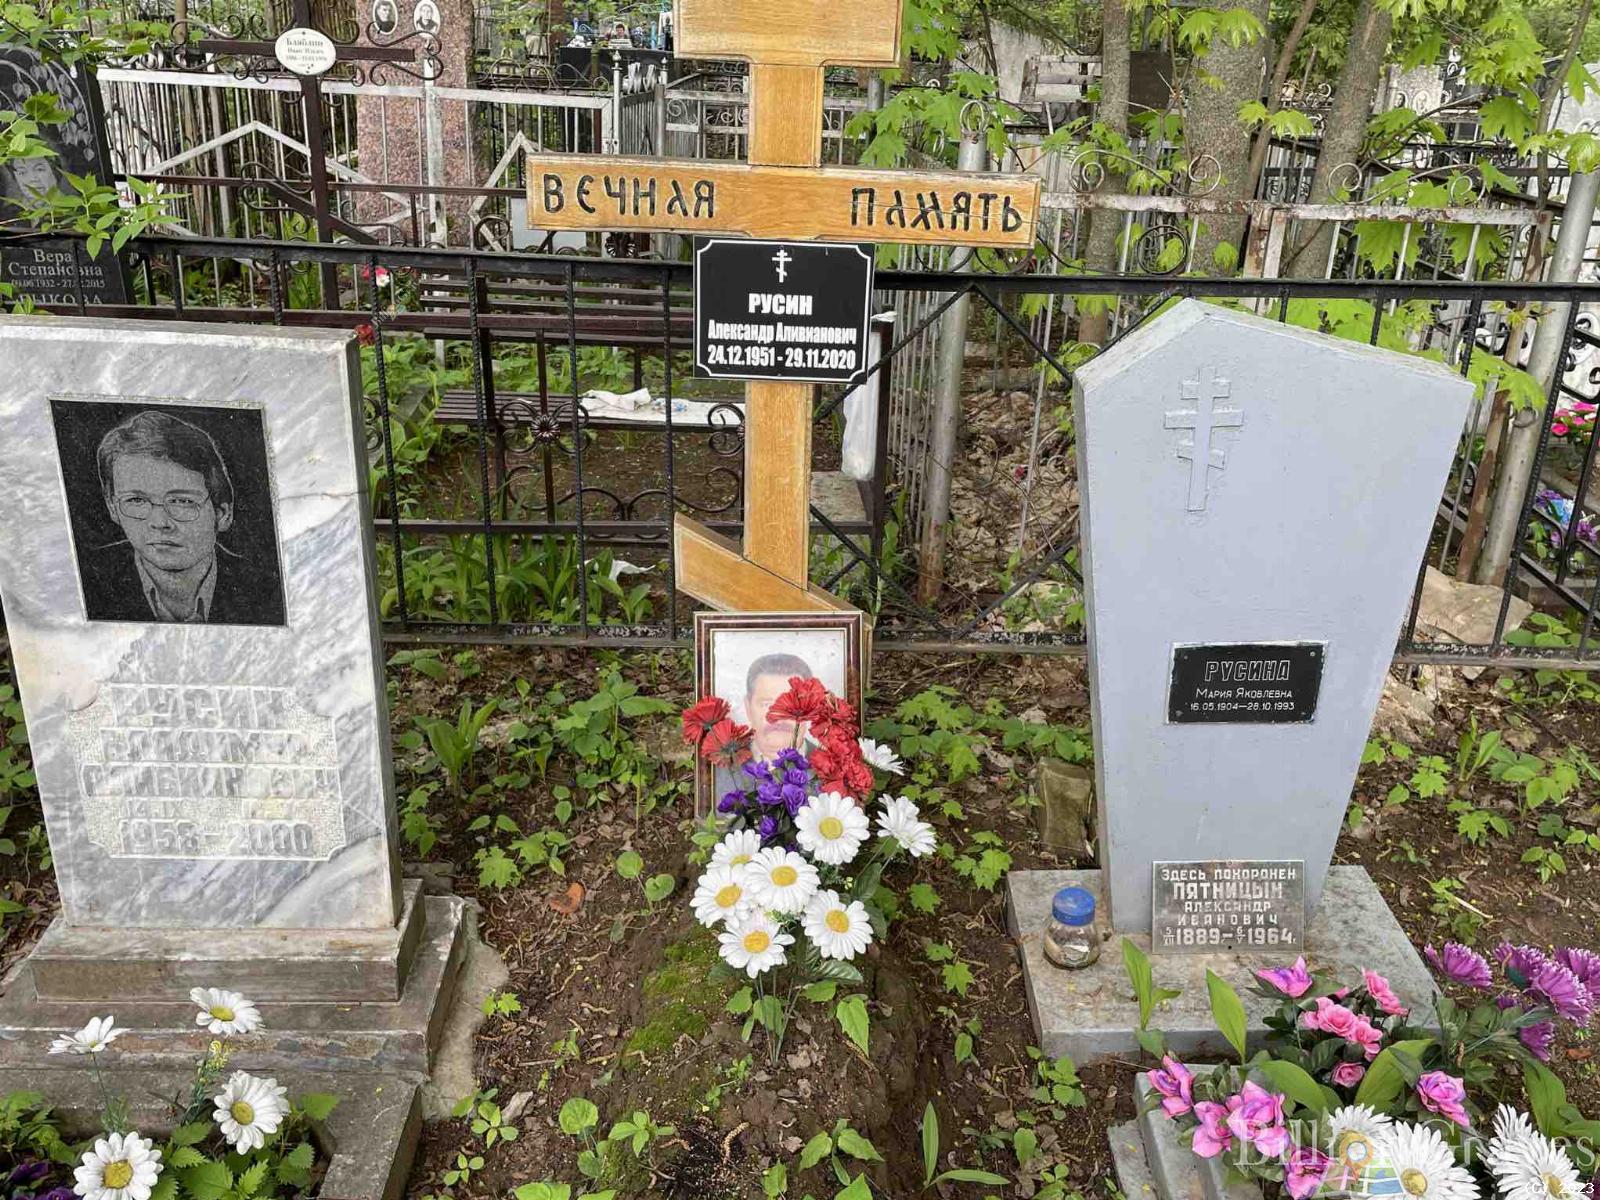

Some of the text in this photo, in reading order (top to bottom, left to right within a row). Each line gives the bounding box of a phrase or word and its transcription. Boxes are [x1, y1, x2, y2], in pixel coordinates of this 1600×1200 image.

[33, 248, 72, 266] Вера
[748, 293, 813, 316] РУСИН
[707, 319, 857, 345] Александр Аливианович
[707, 344, 776, 367] 24.12.1951
[784, 347, 857, 370] 29.11.2020
[1204, 660, 1291, 682] РУСИНА
[1161, 869, 1296, 881] ЗДЕСЬ ПОХОРОНЕН
[1173, 882, 1282, 900] ПЯТНИЦЫН
[1184, 902, 1272, 913] АЛЕКСАНДР
